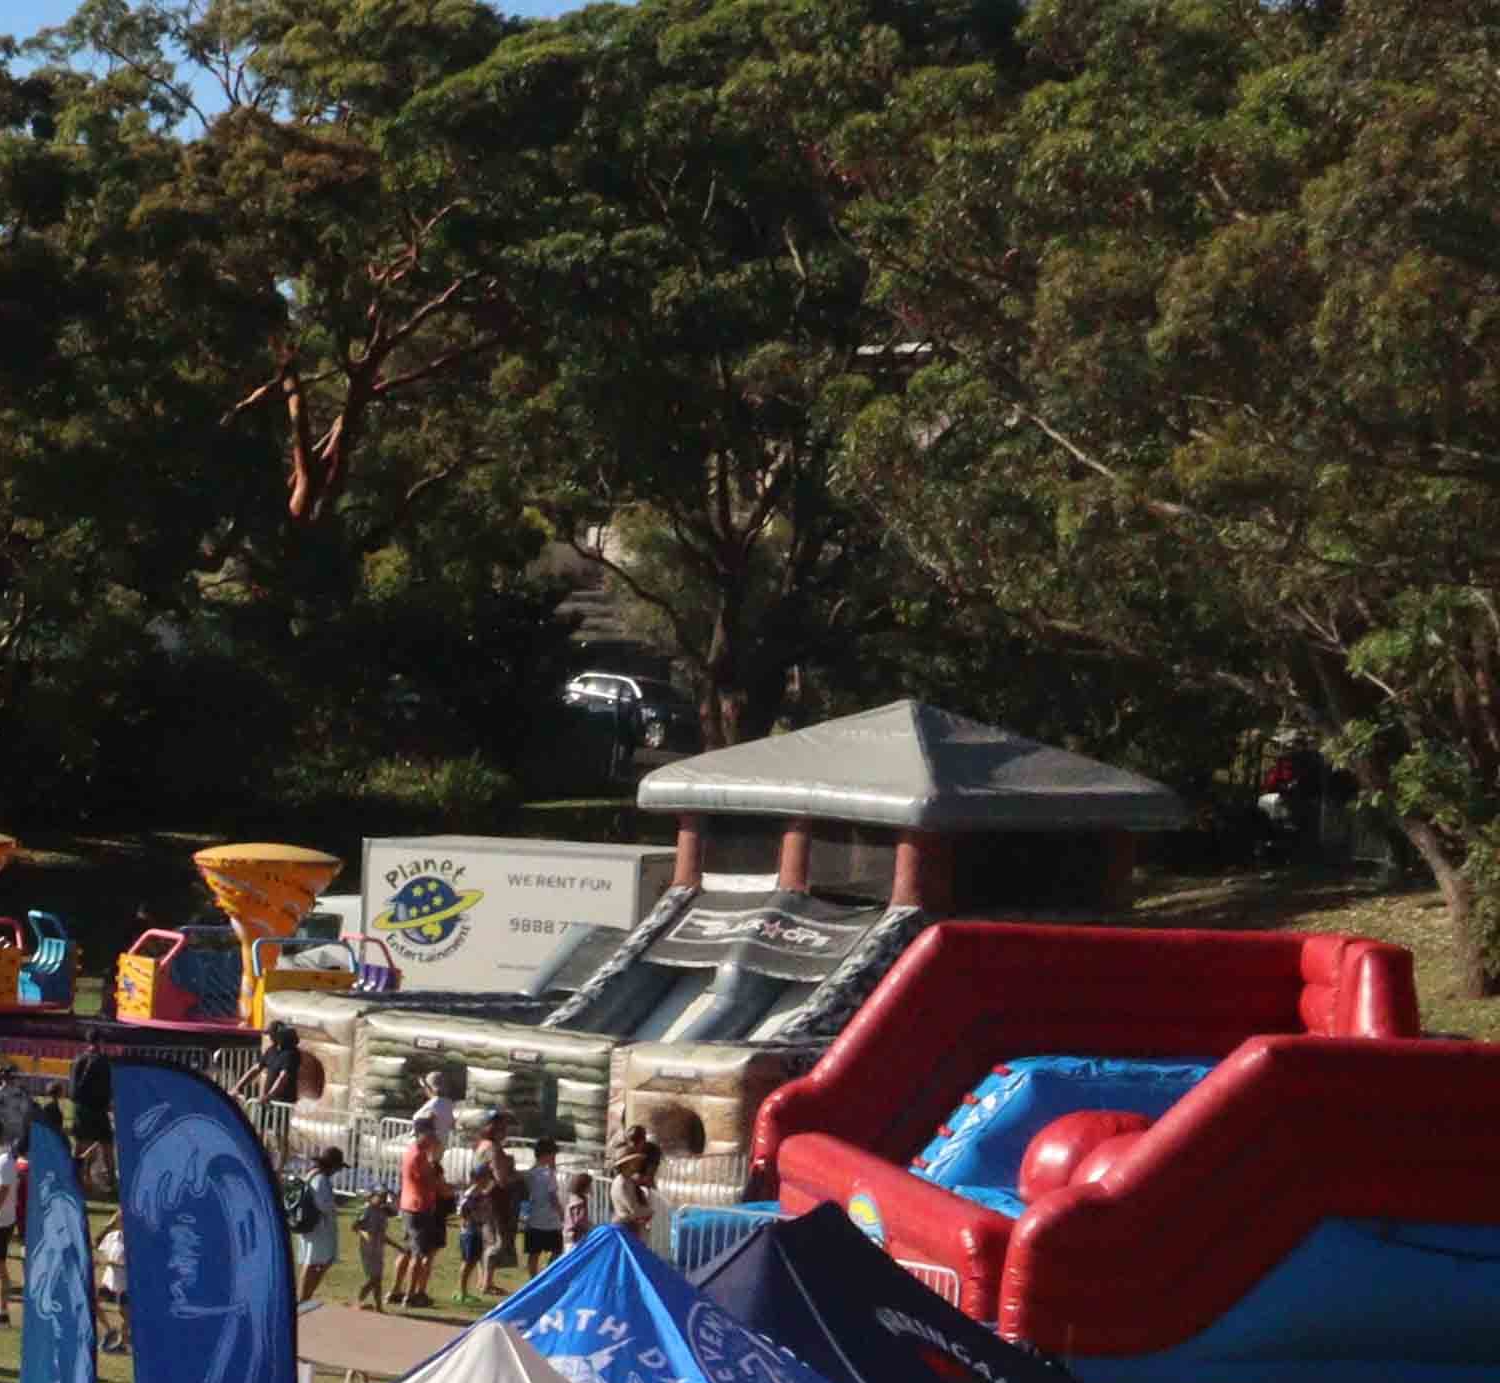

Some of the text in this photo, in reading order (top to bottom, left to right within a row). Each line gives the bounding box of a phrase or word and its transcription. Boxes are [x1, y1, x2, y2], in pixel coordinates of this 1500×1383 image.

[385, 858, 467, 888] Planet
[507, 873, 611, 891] WE RENT FUN
[509, 917, 554, 934] 9888
[386, 914, 471, 963] Entertainment
